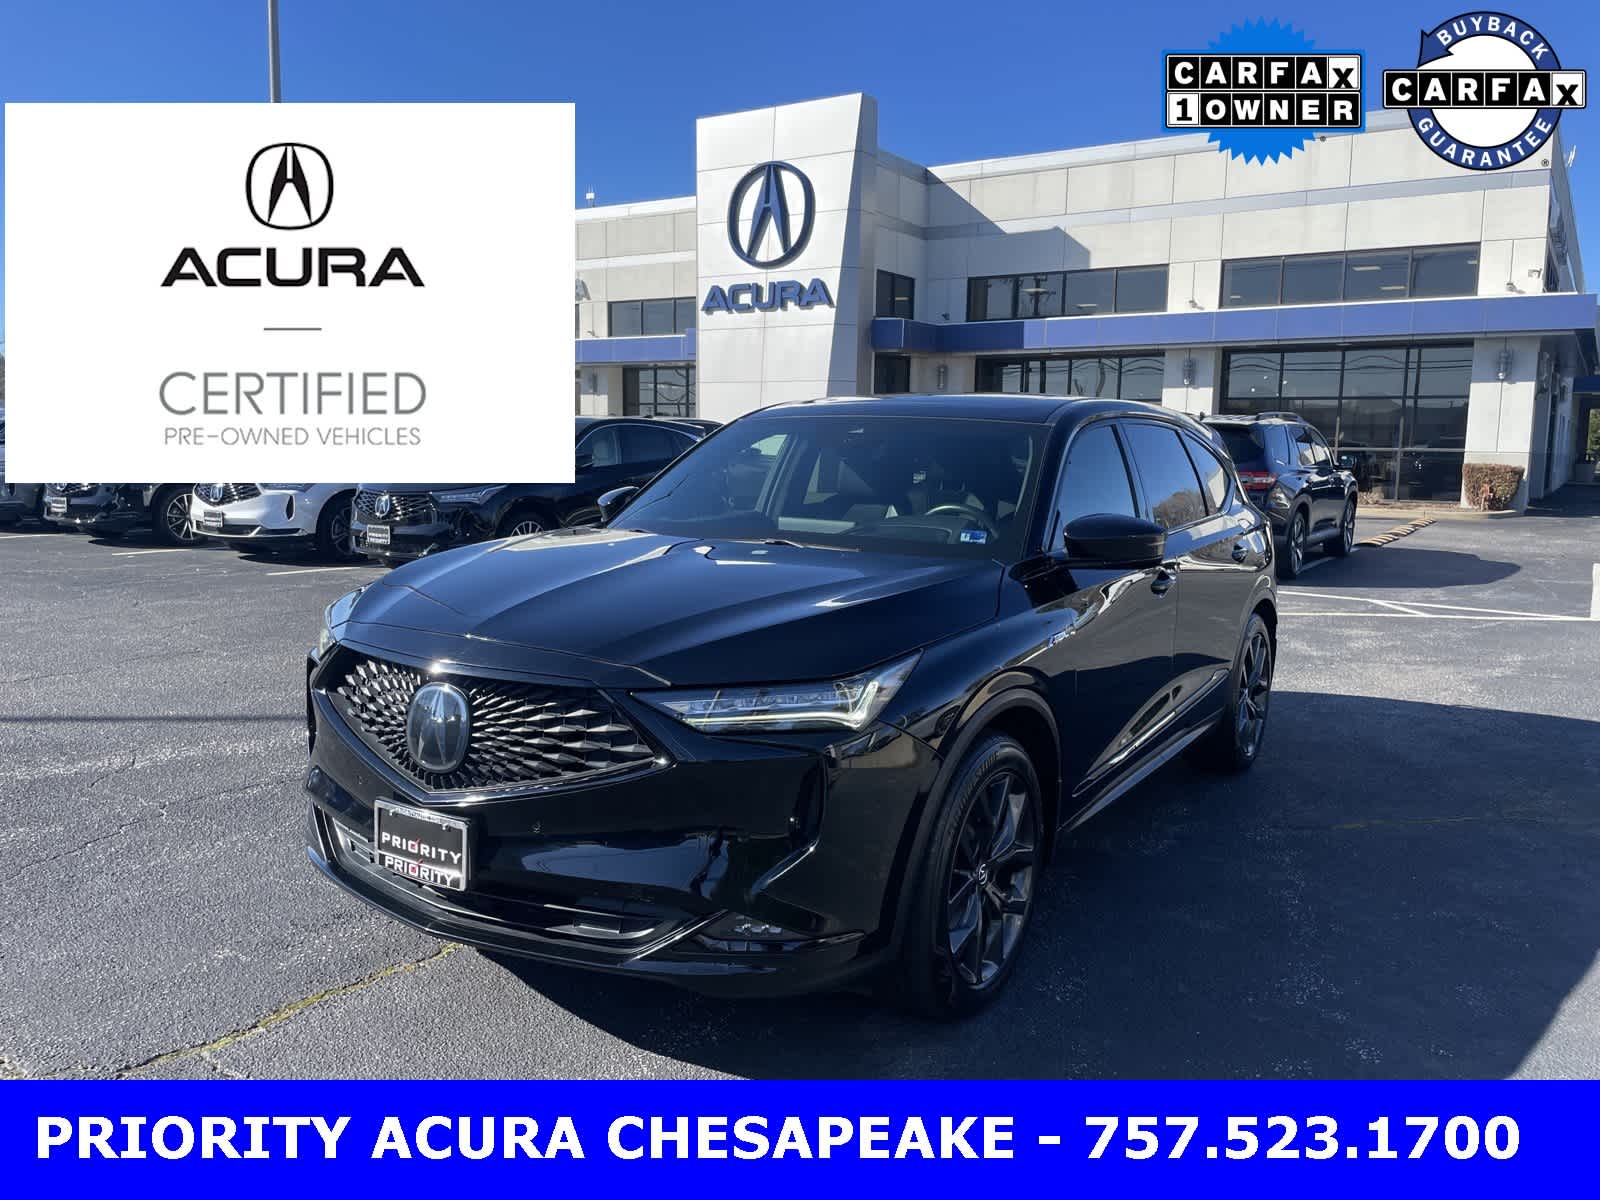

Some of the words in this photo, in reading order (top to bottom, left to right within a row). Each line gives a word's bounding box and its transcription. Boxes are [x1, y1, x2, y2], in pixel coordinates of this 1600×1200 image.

[701, 277, 836, 314] ACURA
[381, 831, 462, 865] PRIORITY
[384, 855, 454, 888] PRIORITY
